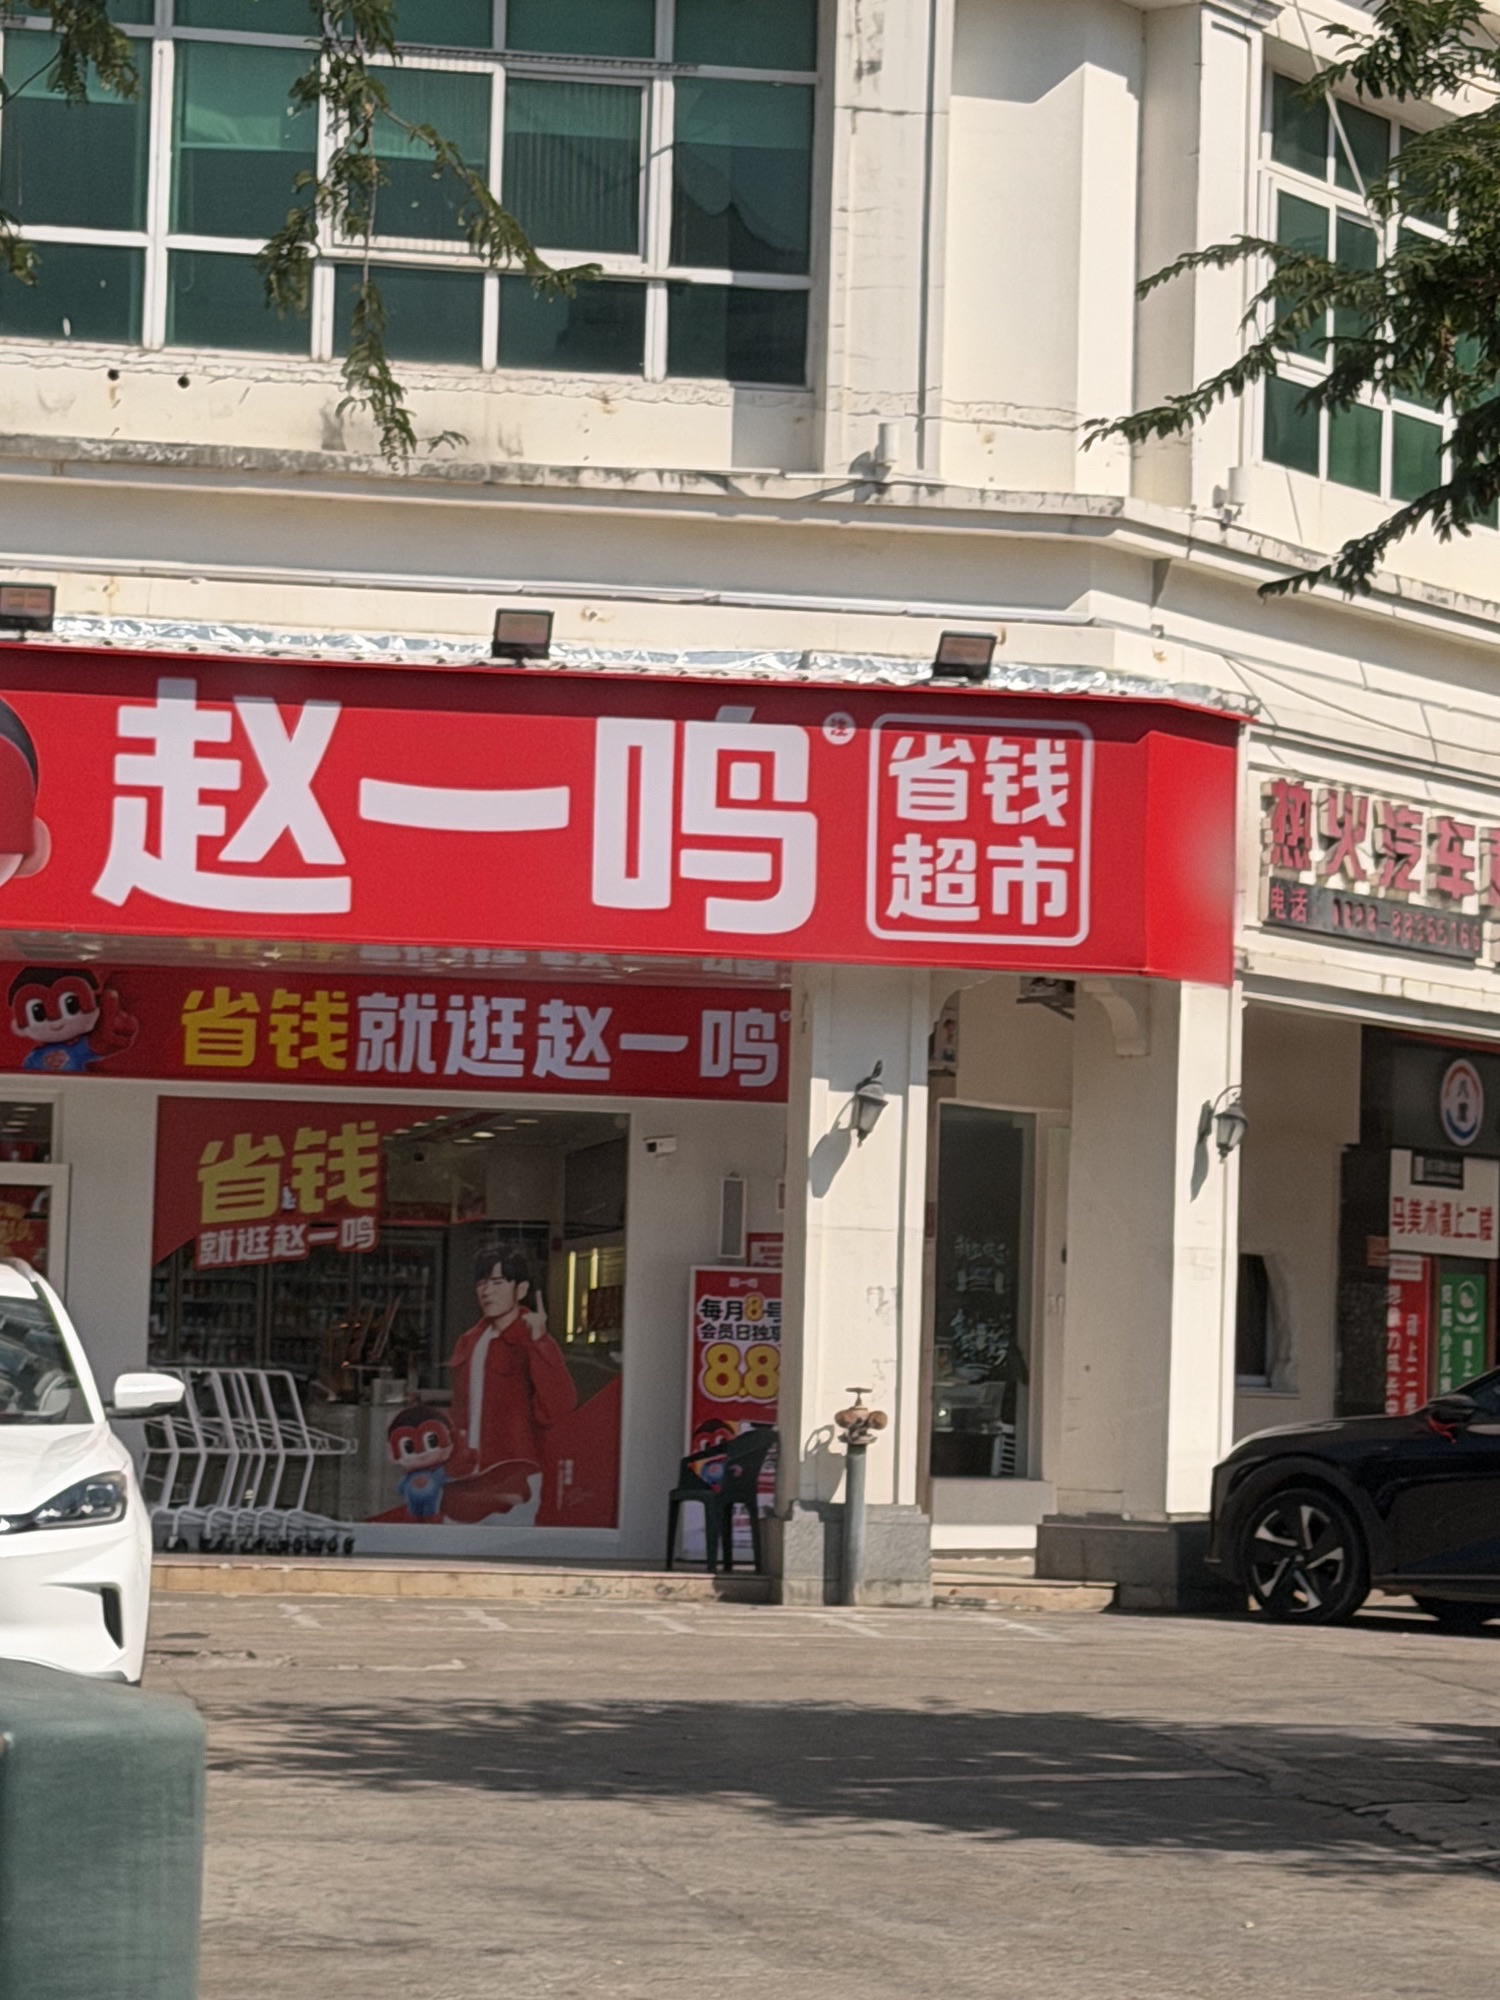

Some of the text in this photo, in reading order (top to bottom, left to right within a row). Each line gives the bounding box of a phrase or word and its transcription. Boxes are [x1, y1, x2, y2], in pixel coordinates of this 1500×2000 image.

[92, 678, 818, 935] 赵一鸣
[888, 734, 1070, 827] 省钱
[885, 833, 1075, 926] 超市
[1270, 778, 1500, 904] 热火汽车
[181, 986, 780, 1088] 省钱就逛赵一鸣
[197, 1120, 379, 1225] 省钱
[199, 1216, 377, 1266] 就逛赵一鸣
